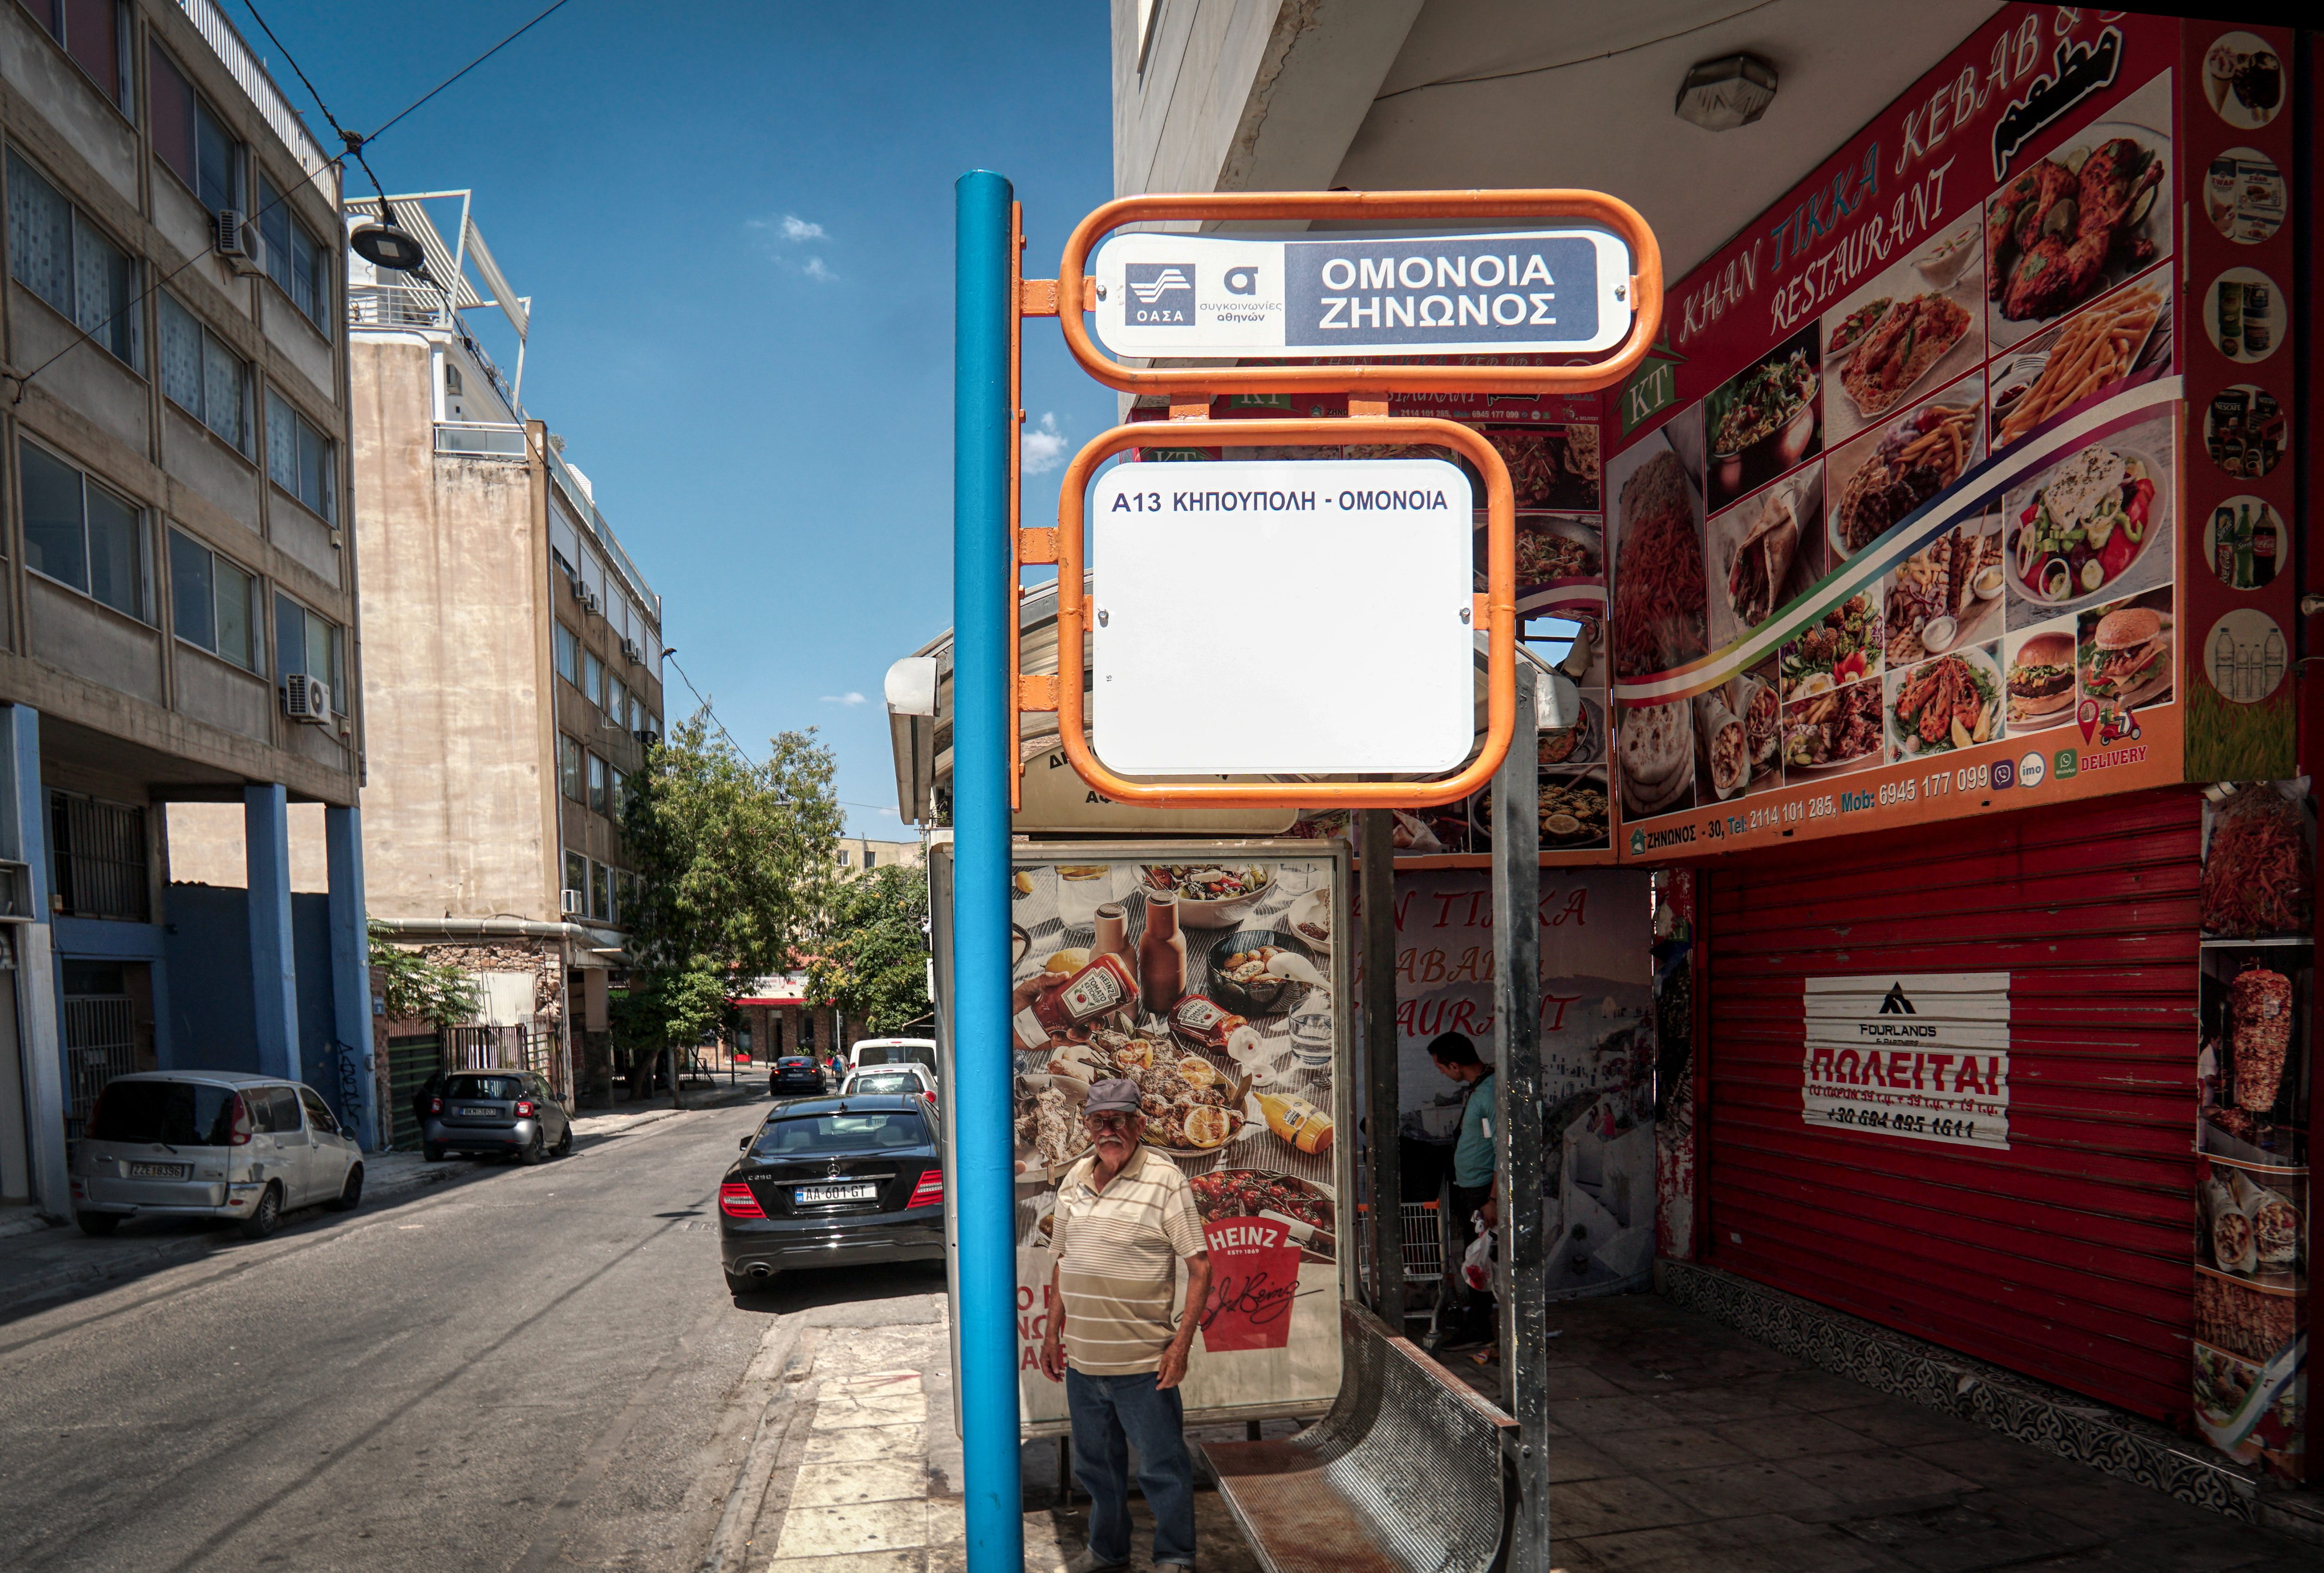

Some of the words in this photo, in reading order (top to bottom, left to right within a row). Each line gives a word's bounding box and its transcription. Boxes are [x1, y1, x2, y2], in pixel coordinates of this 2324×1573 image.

[1678, 236, 1762, 344] KHAN
[1769, 141, 1879, 271] TIKKA
[1895, 9, 2040, 175] KEBAB
[1769, 153, 1957, 336] RESTAURANT
[1322, 254, 1555, 291] ΟΜΟΝΟΙΑ
[1137, 310, 1184, 322] ΟΑΣΑ
[1200, 301, 1282, 313] συγκοινωνίες
[1217, 312, 1265, 324] αθηνών
[1319, 292, 1557, 330] ΖΗΝΩΝΟΣ
[1630, 364, 1668, 424] KT
[1111, 492, 1162, 512] Α13
[1173, 491, 1316, 512] ΚΗΠΟΥΠΟΛΗ
[1339, 490, 1448, 511] ΟΜΟΝΟΙΑ
[2023, 765, 2041, 776] imo
[2081, 746, 2147, 772] DELIVERY
[1728, 816, 1748, 836] Tel:
[1750, 806, 1779, 830] 2114
[1782, 801, 1804, 823] 101
[1809, 796, 1837, 822] 285,
[1841, 790, 1875, 814] Mob:
[1879, 779, 1917, 806] 6945
[1921, 771, 1951, 798] 177
[1956, 765, 1988, 793] 099
[1647, 824, 1696, 850] ΖΗΝΩΝΟΣ
[1708, 822, 1725, 842] 30,
[1083, 982, 1101, 1004] KETCHUP
[1088, 977, 1107, 1002] TOMATO
[1099, 974, 1115, 994] HEINZ
[1183, 1002, 1199, 1015] HEINZ
[1187, 1004, 1207, 1021] TOMATO
[1193, 1006, 1209, 1022] KETCHUP
[1859, 1024, 1936, 1037] FOURLANDS
[1810, 1048, 1999, 1096] ΠΩΛΕΙΤΑΙ
[1827, 1107, 1855, 1124] +30
[1932, 1117, 1974, 1139] 1611
[806, 1185, 866, 1201] AA-601-GT
[1208, 1226, 1278, 1251] HEINZ
